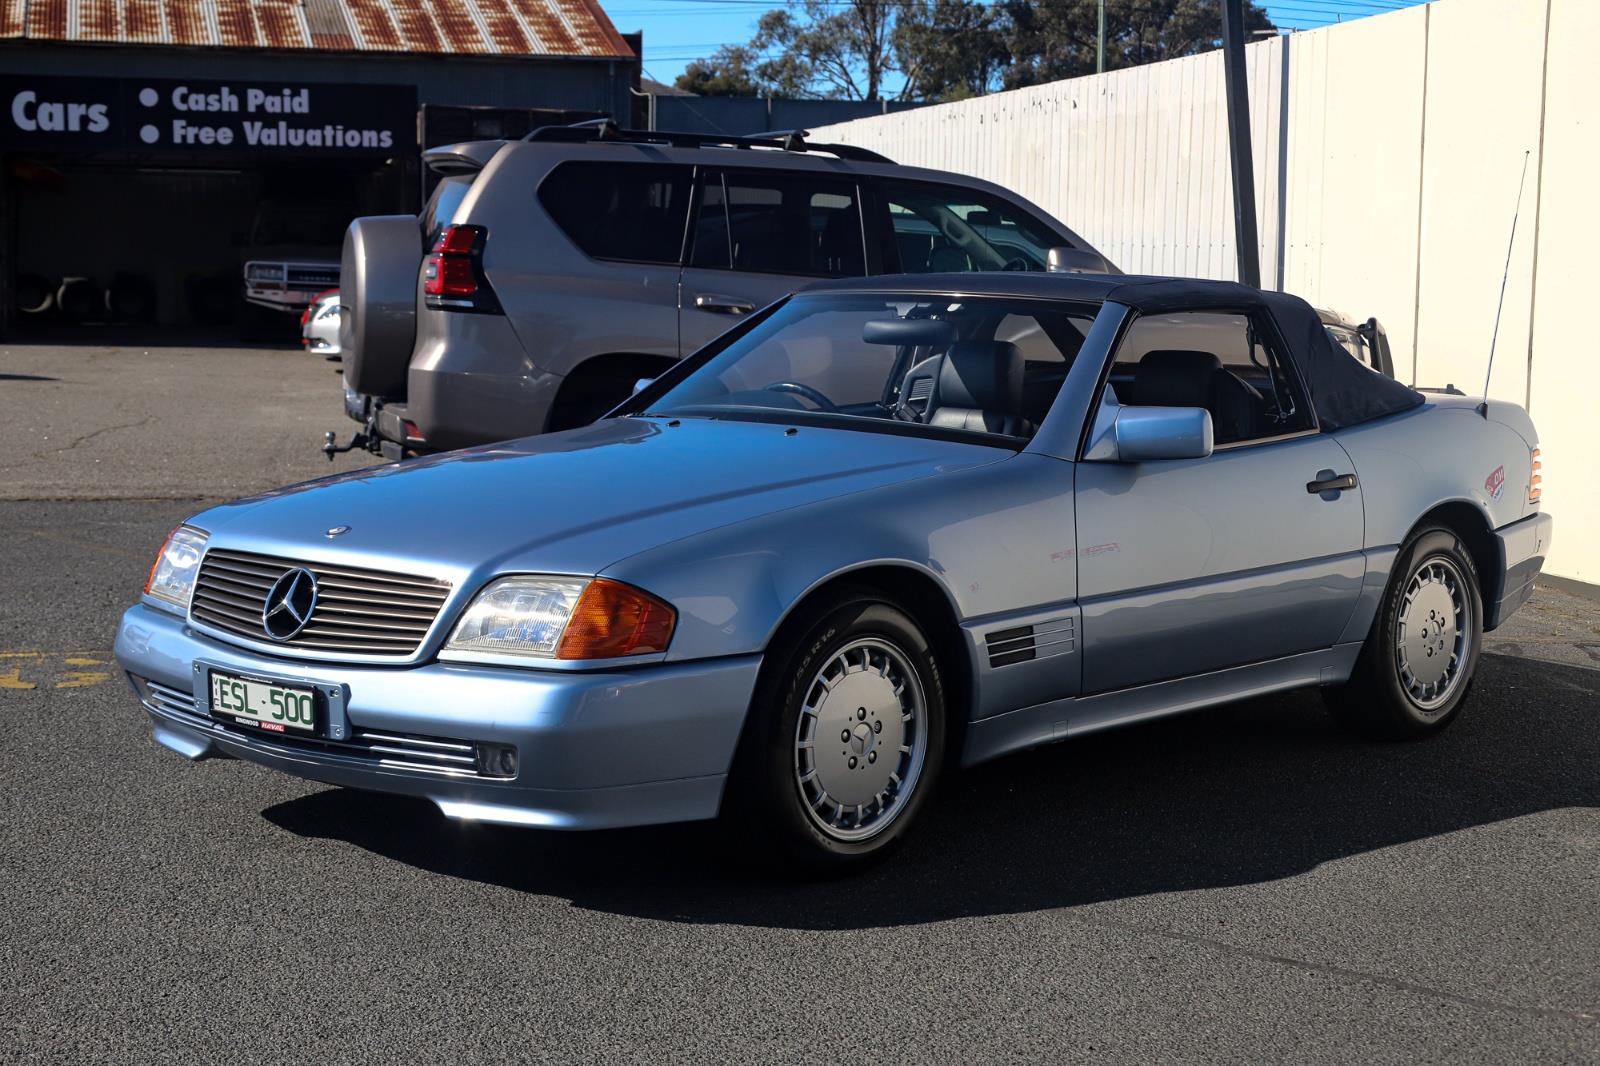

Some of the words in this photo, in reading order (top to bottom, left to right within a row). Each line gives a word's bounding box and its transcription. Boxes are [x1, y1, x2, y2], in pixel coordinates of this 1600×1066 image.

[12, 91, 109, 132] Cars
[172, 87, 239, 112] Cash
[247, 89, 309, 113] Paid
[172, 120, 233, 144] Free
[243, 121, 393, 147] Valuations
[220, 679, 258, 715] ESL
[270, 688, 313, 724] 500
